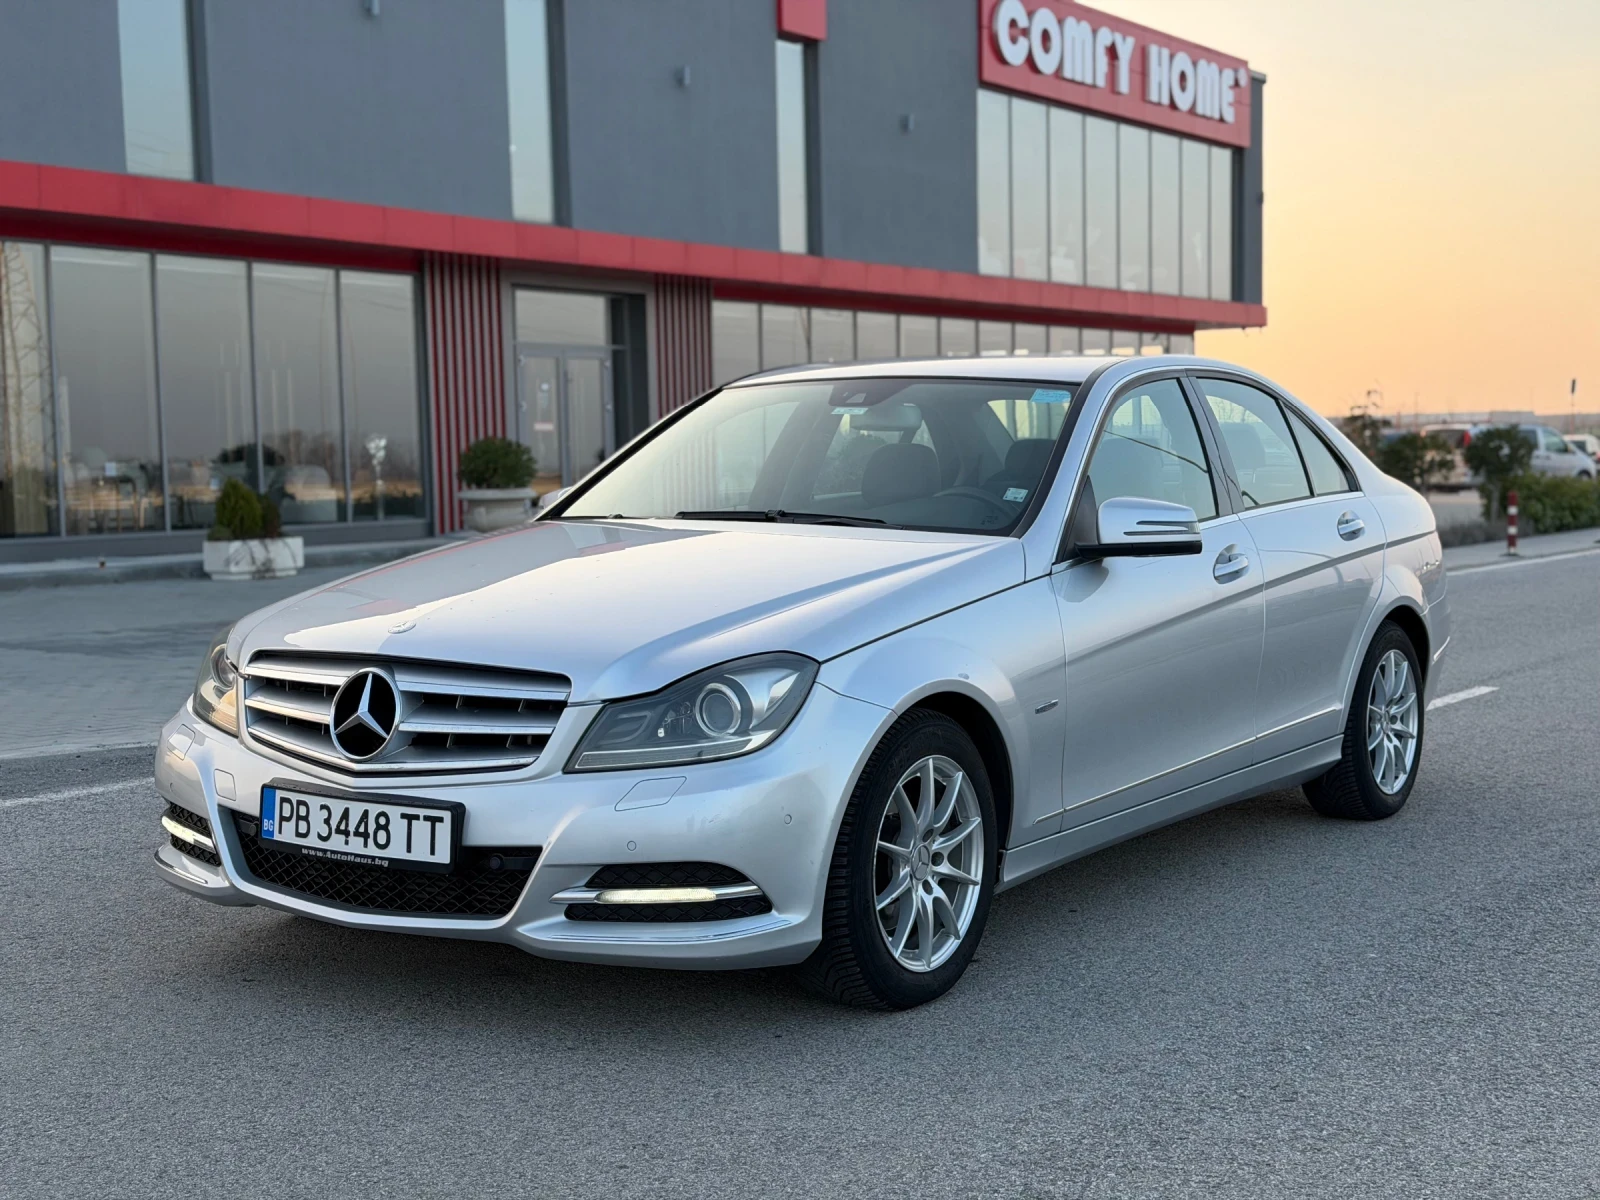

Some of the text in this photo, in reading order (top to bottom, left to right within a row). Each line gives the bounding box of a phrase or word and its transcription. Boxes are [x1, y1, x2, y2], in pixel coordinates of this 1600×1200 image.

[995, 0, 1235, 124] COMFY HOME
[263, 819, 274, 832] BG
[277, 796, 445, 856] PB 3448 TT
[301, 847, 389, 868] www.AutoHaus.bg
